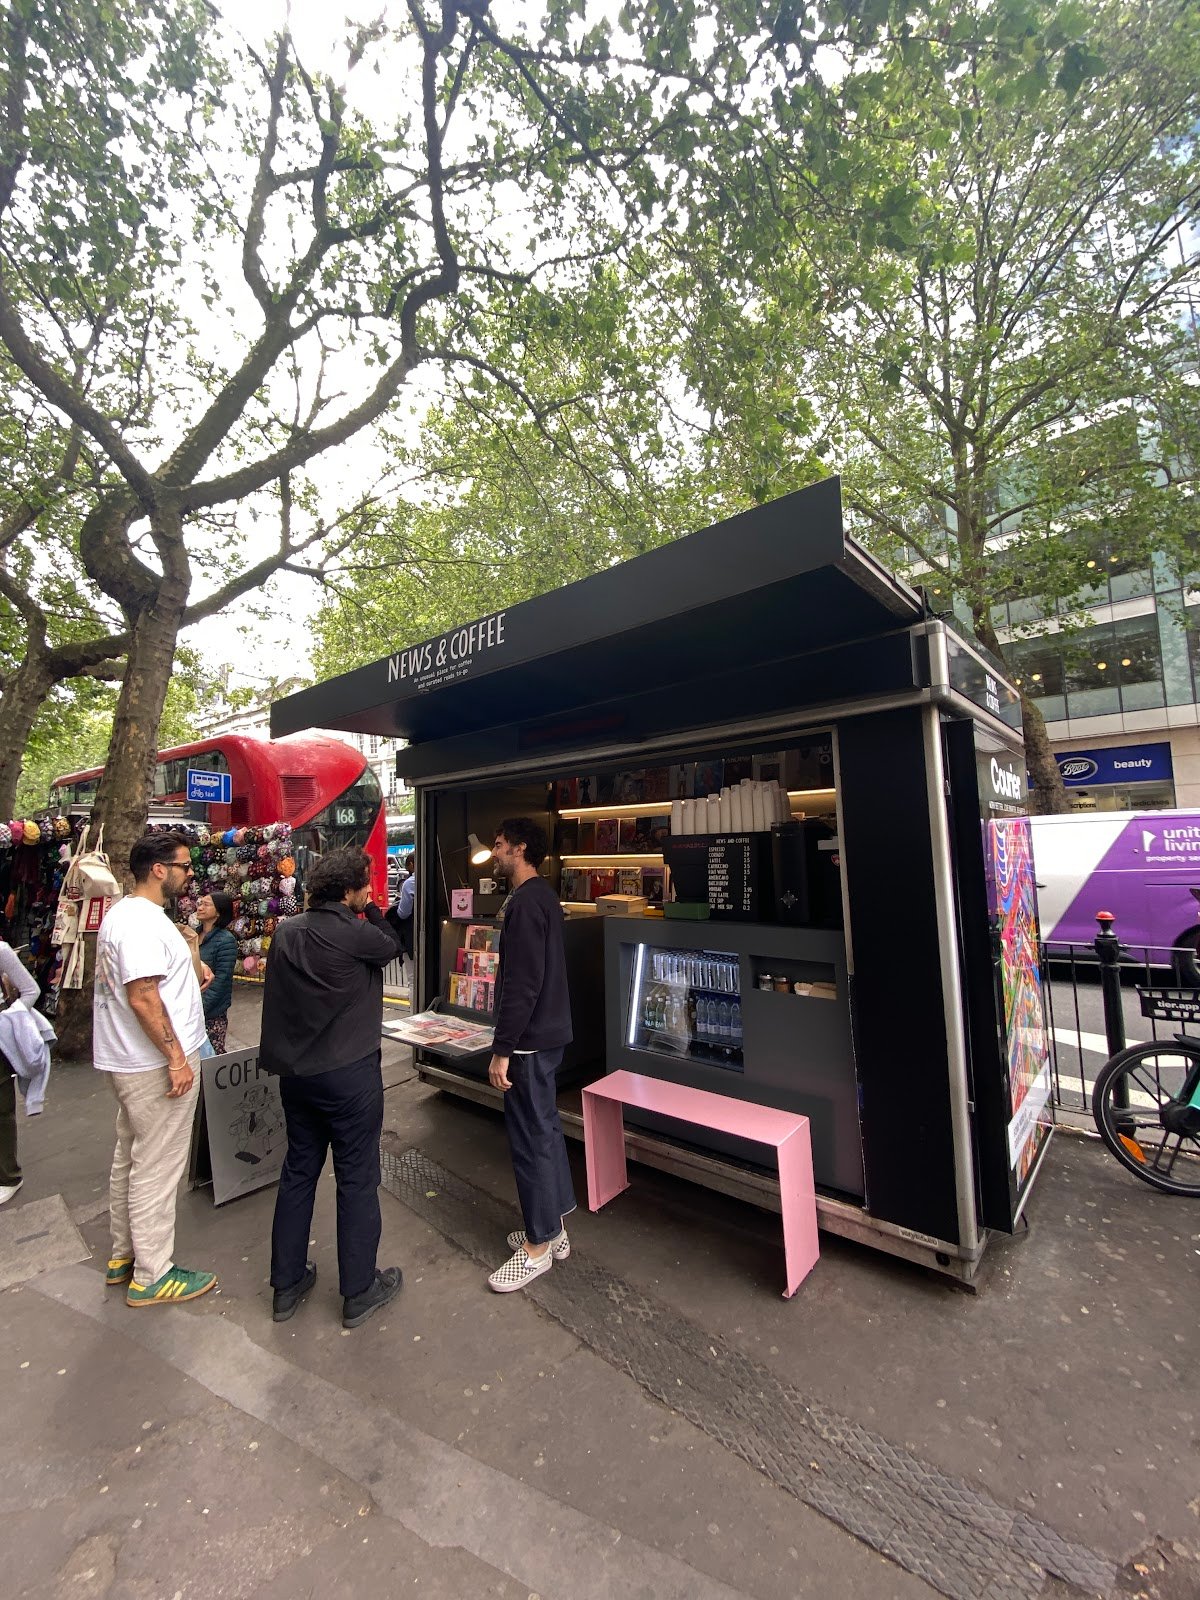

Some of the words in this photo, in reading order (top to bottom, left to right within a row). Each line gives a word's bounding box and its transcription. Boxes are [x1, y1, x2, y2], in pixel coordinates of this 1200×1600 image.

[388, 643, 432, 683] NEWS
[436, 638, 447, 667] &
[450, 612, 506, 660] COFFEE
[1061, 762, 1090, 776] Boots
[1113, 759, 1152, 769] beauty
[990, 757, 1021, 800] Courier
[1069, 801, 1097, 809] scriptions
[336, 808, 355, 824] 168
[1157, 1000, 1200, 1011] tier.app
[214, 1057, 271, 1090] COF
